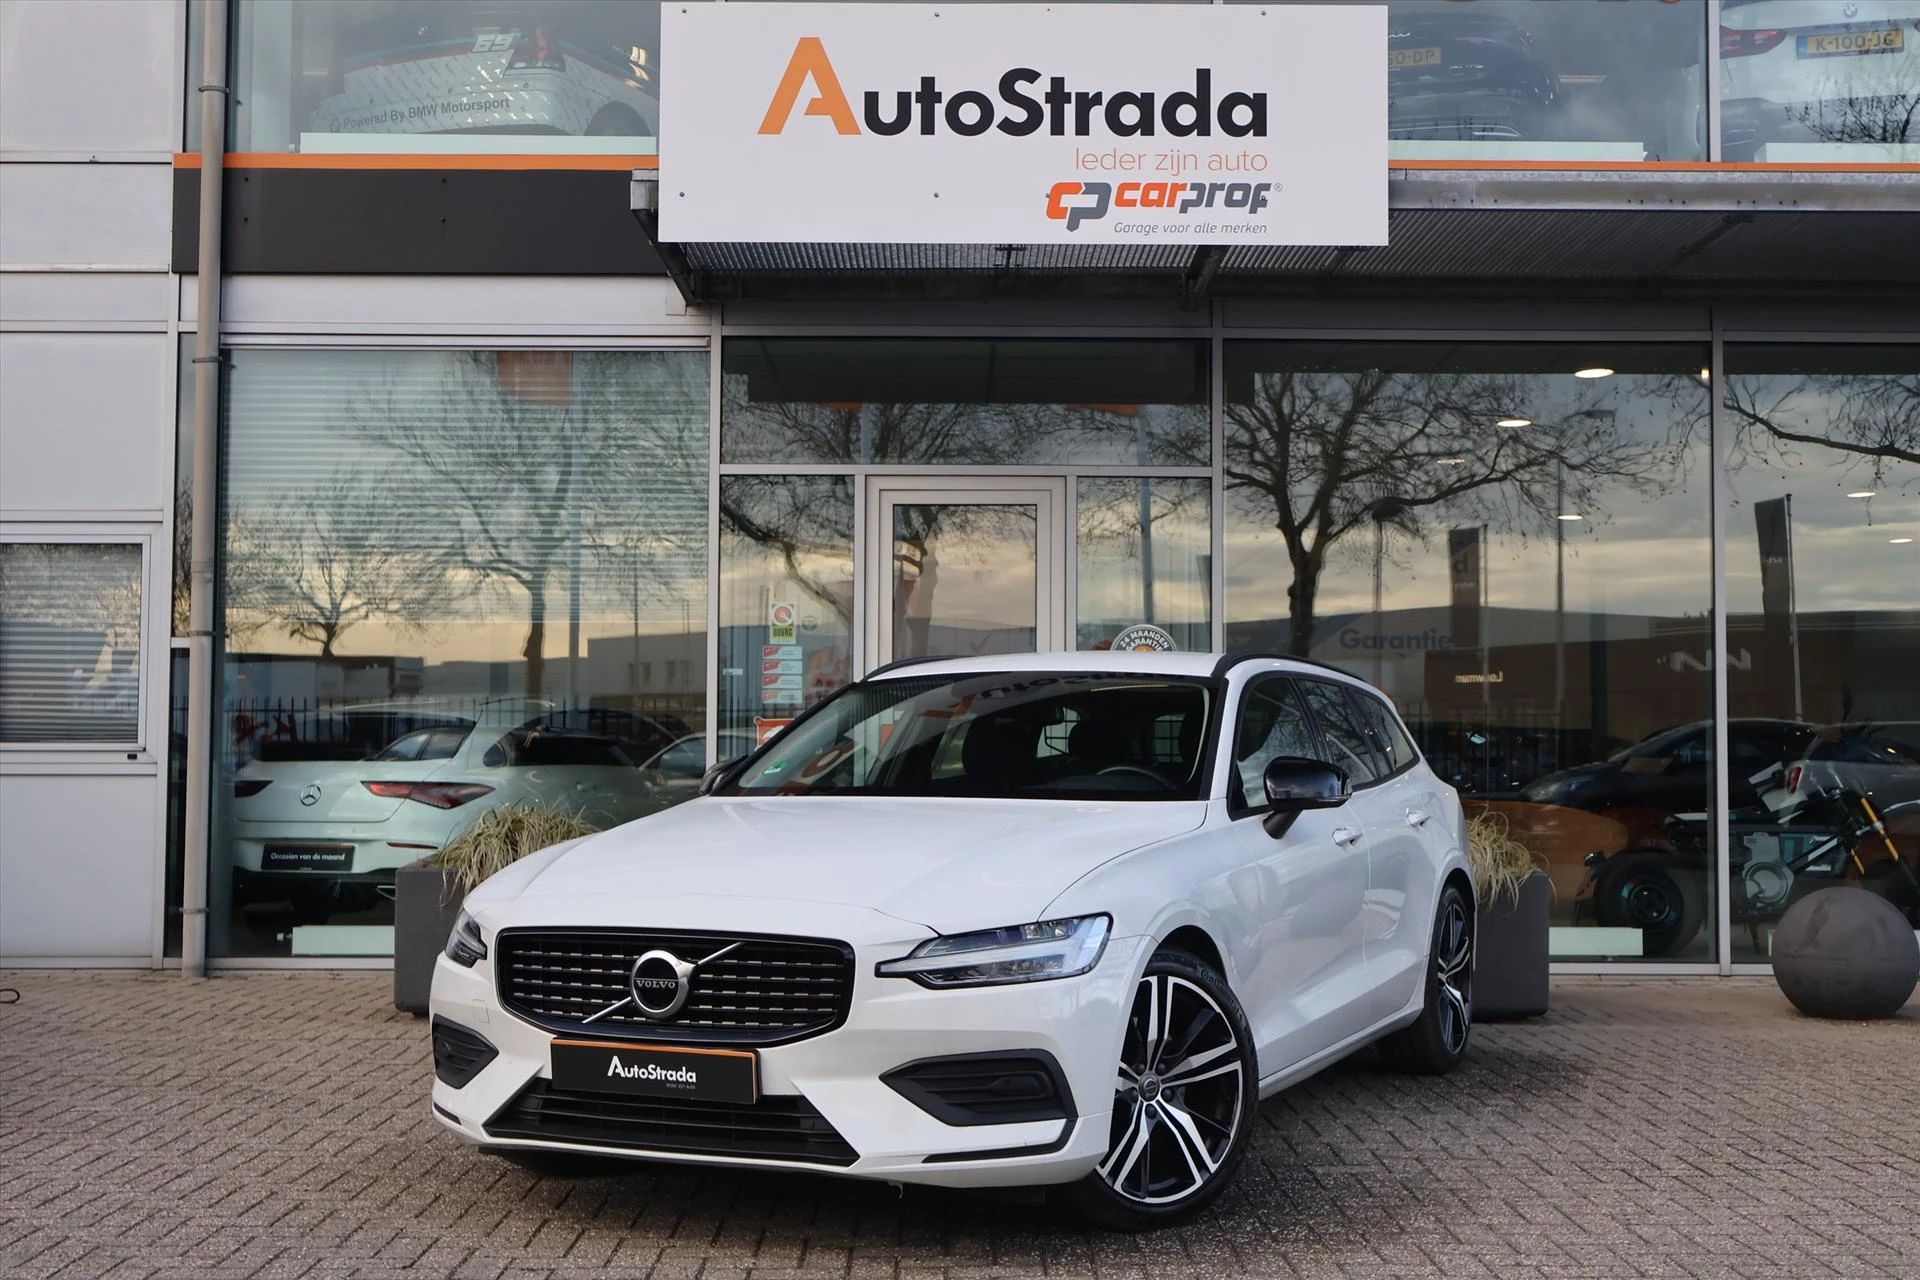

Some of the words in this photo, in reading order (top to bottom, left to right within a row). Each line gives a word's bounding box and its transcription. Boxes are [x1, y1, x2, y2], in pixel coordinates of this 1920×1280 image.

[757, 37, 1268, 138] AutoStrada
[343, 110, 388, 129] Powered
[390, 109, 405, 125] By
[408, 104, 438, 119] BMW
[441, 99, 511, 114] Motorsport
[1075, 148, 1147, 171] Ieder
[1154, 149, 1198, 177] zijn
[1207, 150, 1268, 172] auto
[1114, 222, 1158, 236] Garage
[1163, 224, 1191, 234] voor
[1194, 222, 1217, 234] alle
[1221, 222, 1267, 234] merken
[1120, 637, 1130, 648] 24
[1130, 630, 1169, 649] MAANDEN
[1339, 628, 1452, 650] Garantie
[270, 852, 298, 860] Occasion
[312, 852, 320, 860] de
[321, 852, 346, 861] maand
[636, 980, 676, 989] VOLVO
[607, 1055, 697, 1083] AutoStrada
